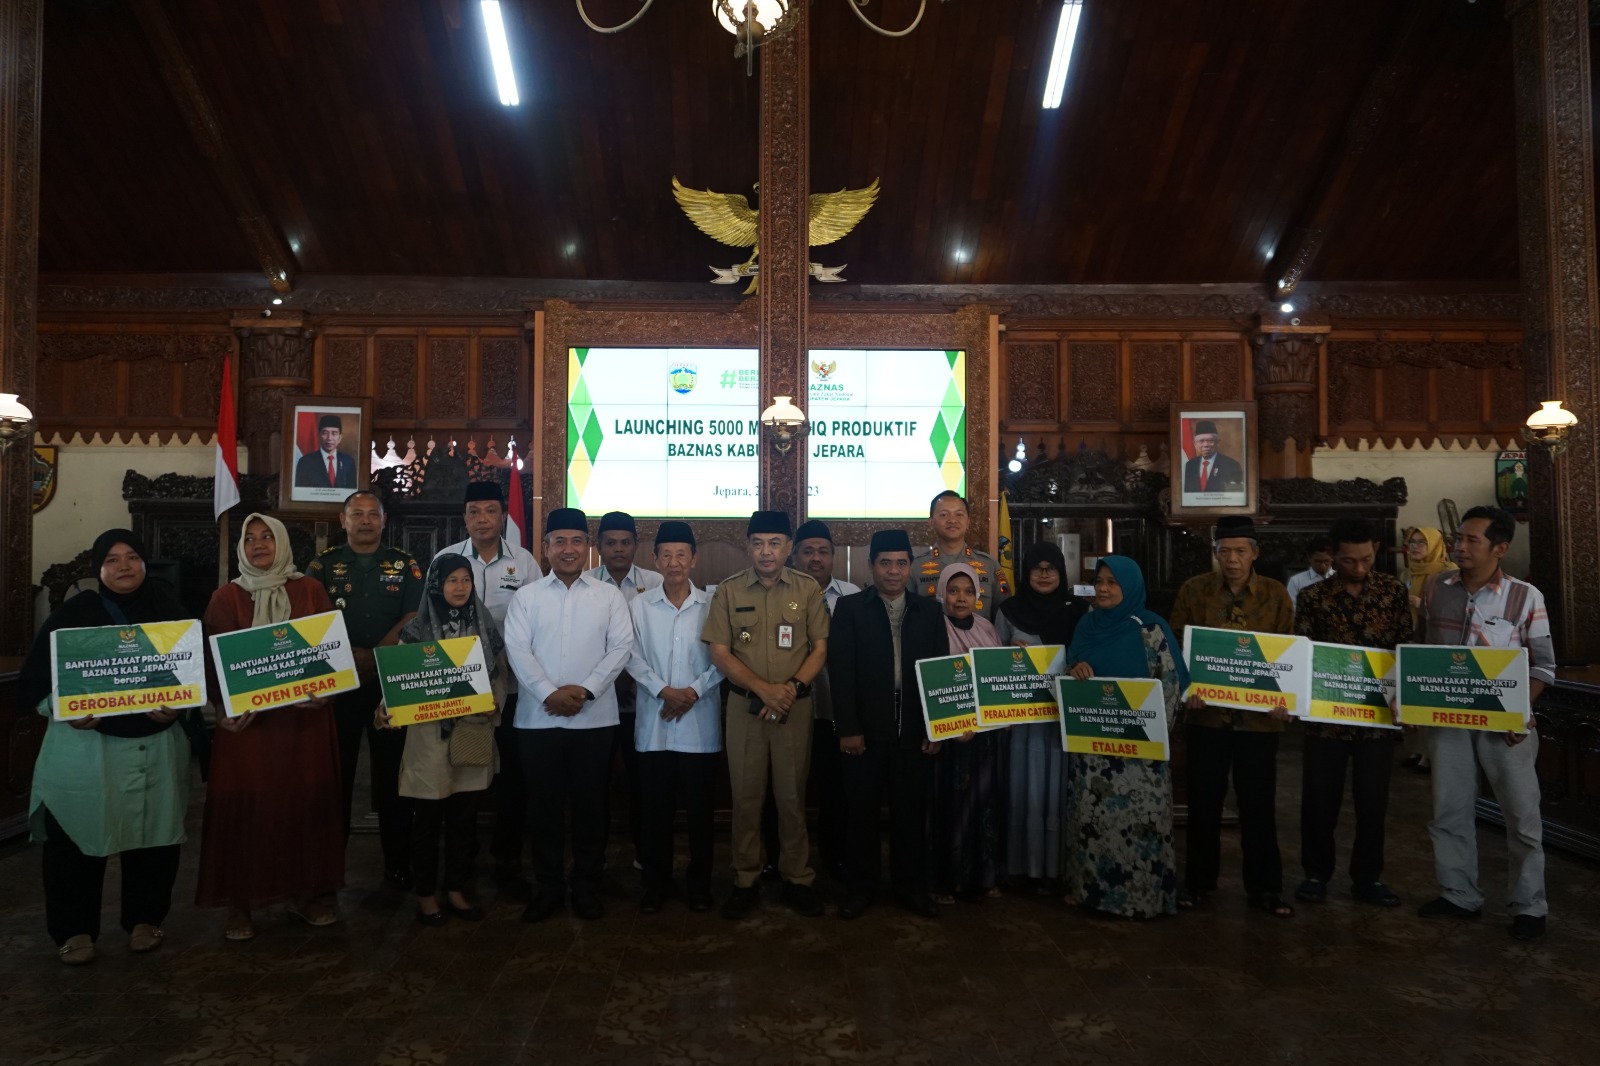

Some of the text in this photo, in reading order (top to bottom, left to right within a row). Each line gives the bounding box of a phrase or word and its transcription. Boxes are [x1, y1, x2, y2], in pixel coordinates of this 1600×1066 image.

[615, 419, 704, 435] LAUNCHING
[709, 420, 743, 435] 5000
[832, 421, 917, 436] PRODUKTIF
[668, 444, 722, 457] BAZNAS
[813, 444, 865, 458] JEPARA
[713, 485, 751, 499] Jepara,
[65, 652, 192, 670] BANTUAN ZAKAT PRODUKTIF
[230, 656, 269, 671] BANTUAN
[270, 651, 296, 662] ZAKAT
[296, 641, 341, 656] PRODUKTIF
[82, 662, 177, 678] BAZNAS KAB. JEPARA
[246, 652, 330, 677] BAZNAS KAB. JEPARA
[1196, 655, 1293, 672] BANTUAN ZAKAT PRODUKTIF
[275, 668, 305, 679] berupa
[386, 672, 420, 683] BANTUAN
[420, 669, 442, 679] ZAKAT
[444, 664, 481, 675] PRODUKTIF
[1207, 665, 1235, 673] BAZNAS
[1252, 670, 1280, 679] JEPARA
[1314, 672, 1343, 681] BANTUAN
[1344, 675, 1363, 683] ZAKAT
[114, 676, 147, 685] berupa
[400, 673, 472, 690] BAZNAS KAB. JEPARA
[980, 676, 1008, 684] BANTUAN
[1008, 675, 1027, 683] ZAKAT
[1029, 682, 1052, 690] JEPARA
[1230, 675, 1255, 684] berupa
[1406, 676, 1443, 684] BANTUAN
[1471, 680, 1517, 688] PRODUKTIF
[252, 678, 337, 706] OVEN BESAR
[426, 687, 451, 696] berupa
[928, 686, 953, 697] BANTUAN
[953, 684, 970, 694] ZAKAT
[1324, 681, 1348, 690] BAZNAS
[1364, 685, 1388, 694] JEPARA
[1420, 685, 1503, 696] BAZNAS KAB. JEPARA
[68, 690, 192, 711] GEROBAK JUALAN
[938, 694, 959, 704] BAZNAS
[1196, 688, 1287, 707] MODAL USAHA
[1344, 692, 1366, 700] berupa
[1446, 695, 1474, 704] berupa
[418, 699, 465, 713] MESIN JAHIT/
[984, 706, 1059, 719] PERALATAN CATERIN
[1068, 706, 1156, 719] BANTUAN ZAKAT PRODUKTIF
[1333, 706, 1376, 720] PRINTER
[1432, 712, 1488, 726] FREEZER
[934, 719, 972, 734] PERALATAN
[1080, 716, 1105, 724] BAZNAS
[1121, 718, 1146, 727] JEPARA
[1102, 726, 1125, 734] berupa
[1092, 742, 1138, 755] ETALASE
